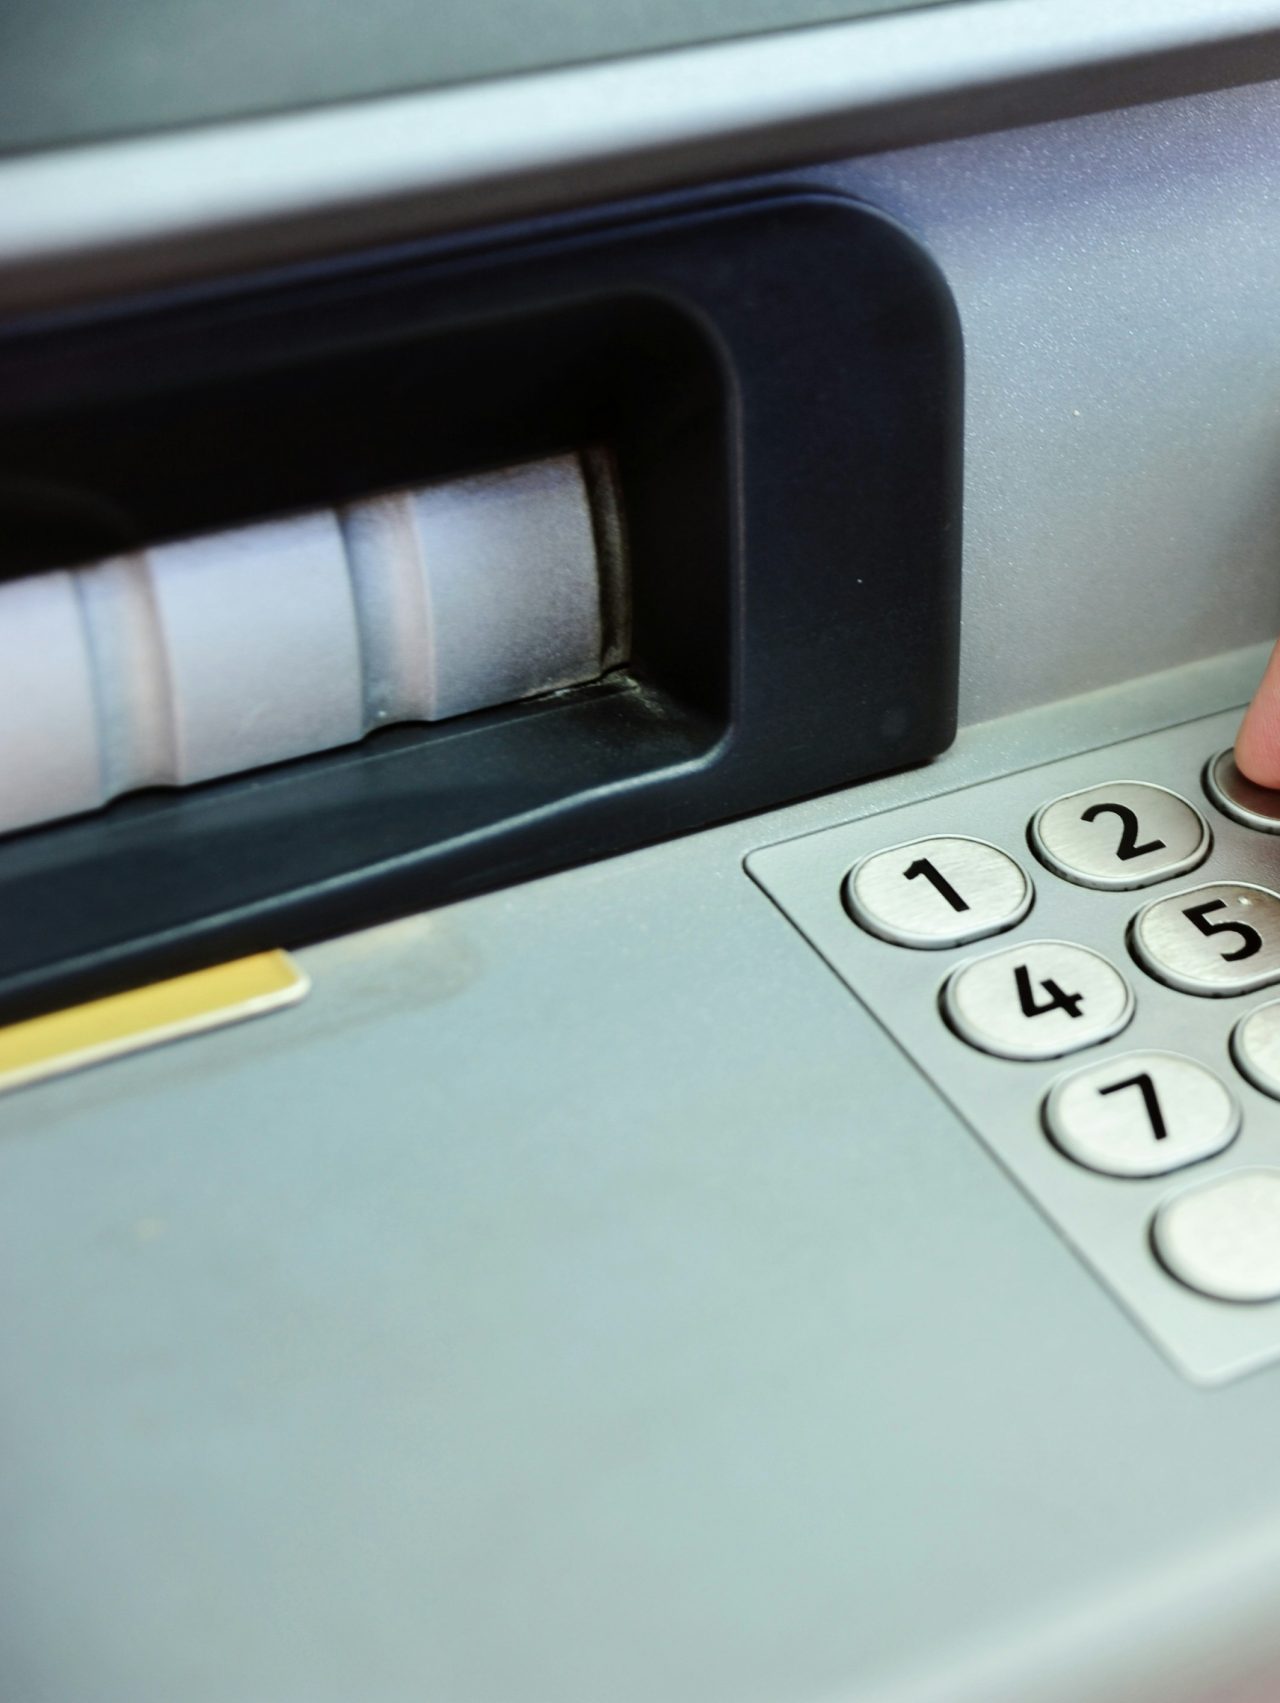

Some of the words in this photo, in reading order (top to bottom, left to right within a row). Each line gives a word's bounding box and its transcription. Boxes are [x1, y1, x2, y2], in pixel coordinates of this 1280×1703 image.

[1081, 804, 1166, 860] 2
[904, 858, 969, 912] 1
[1182, 900, 1262, 961] 5
[1014, 965, 1083, 1018] 4
[1099, 1073, 1167, 1140] 7
